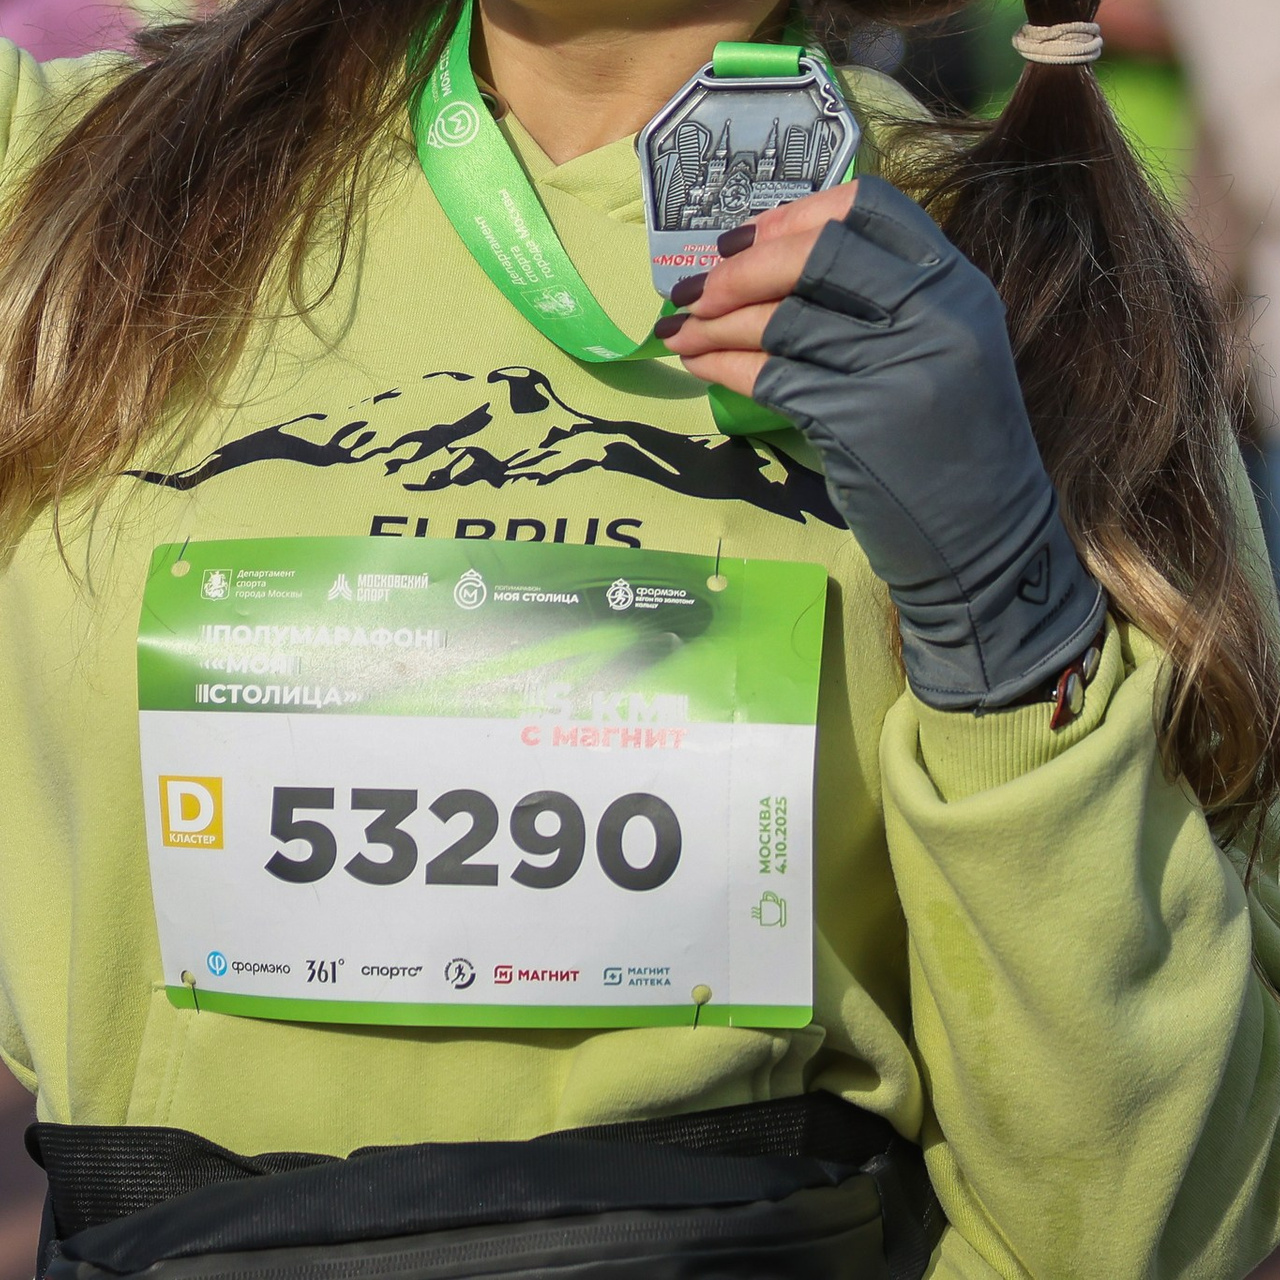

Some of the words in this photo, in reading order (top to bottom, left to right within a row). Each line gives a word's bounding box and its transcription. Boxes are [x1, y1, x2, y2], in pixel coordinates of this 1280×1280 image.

[499, 187, 530, 240] Москвы
[475, 215, 527, 285] Департамент
[525, 240, 555, 279] города
[510, 245, 539, 283] спорта
[236, 569, 296, 579] Департамент
[357, 572, 429, 589] МОСКОВСКИЙ
[235, 590, 266, 599] города
[268, 590, 303, 598] Москвы
[236, 580, 267, 589] спорта
[636, 587, 687, 598] фармэко
[356, 588, 391, 602] СПОРТ
[493, 592, 520, 602] МОЯ
[522, 593, 579, 604] СТОЛИЦА
[210, 623, 436, 649] ПОЛУМАРАФОН
[208, 683, 359, 708] СТОЛИЦА»
[552, 726, 687, 749] магнит
[166, 780, 214, 833] D
[169, 833, 216, 845] КЛАСТЕР
[264, 786, 682, 891] 53290
[759, 796, 771, 874] МОСКВА
[775, 796, 787, 874] 4.10.2025
[231, 960, 291, 974] фармэко
[305, 958, 345, 983] 361°
[518, 969, 580, 982] МАГНИТ
[627, 967, 671, 975] МАГНИТ
[628, 978, 671, 986] АПТЕКА
